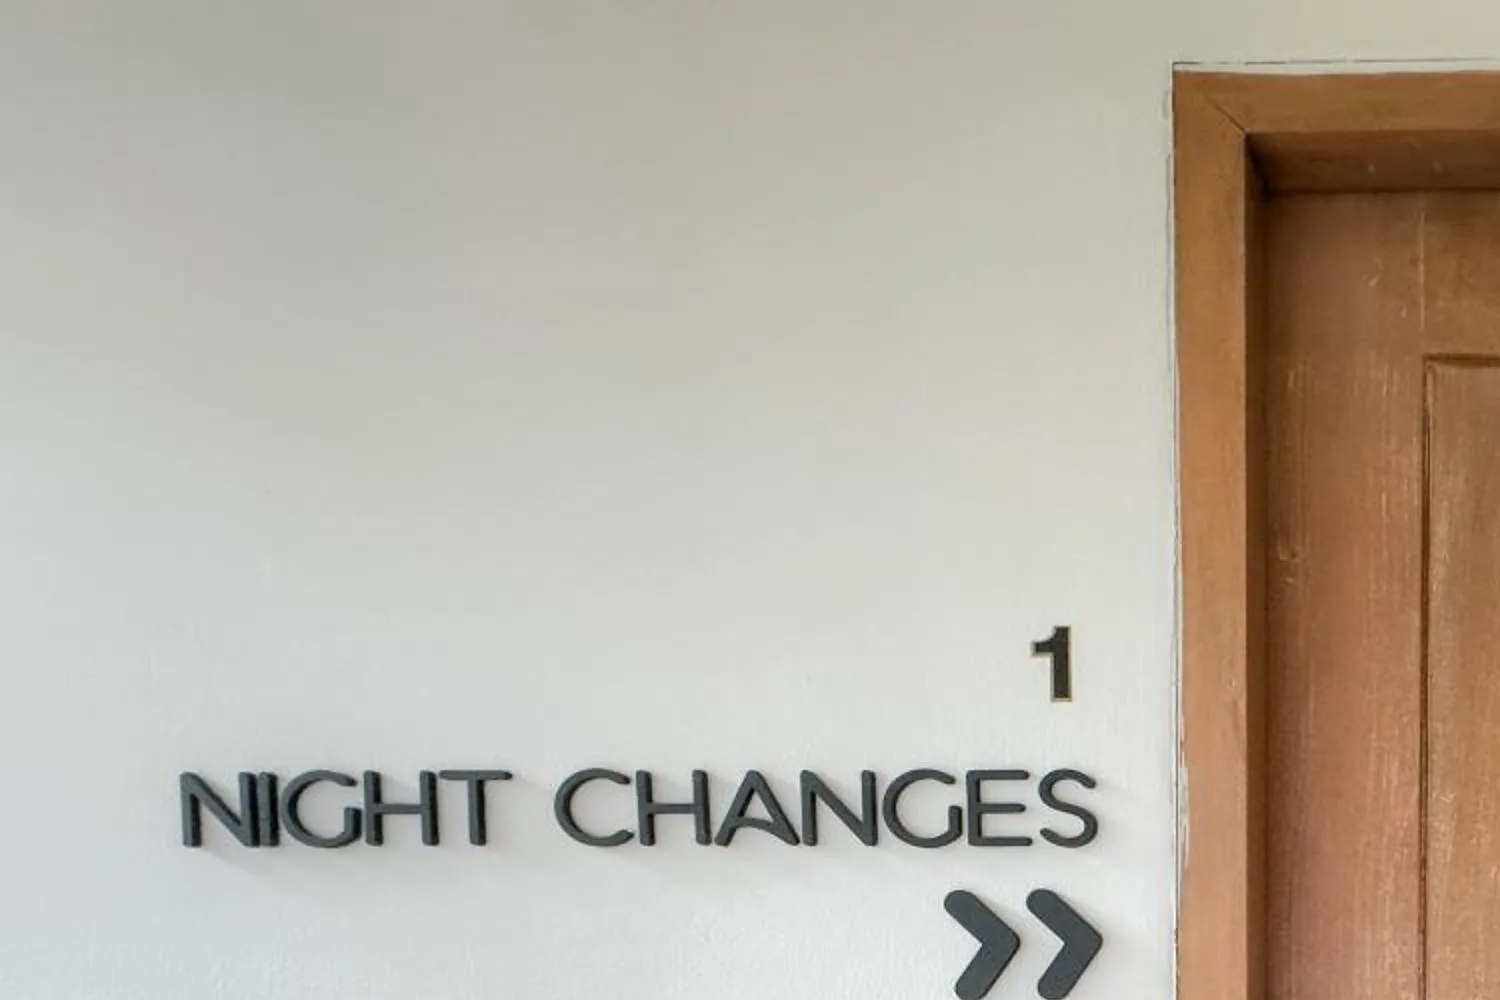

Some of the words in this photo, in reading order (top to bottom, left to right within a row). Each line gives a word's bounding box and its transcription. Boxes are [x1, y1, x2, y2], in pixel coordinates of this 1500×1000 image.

[1031, 625, 1072, 701] 1
[180, 769, 513, 848] NIGHT
[554, 768, 1099, 849] CHANGES
